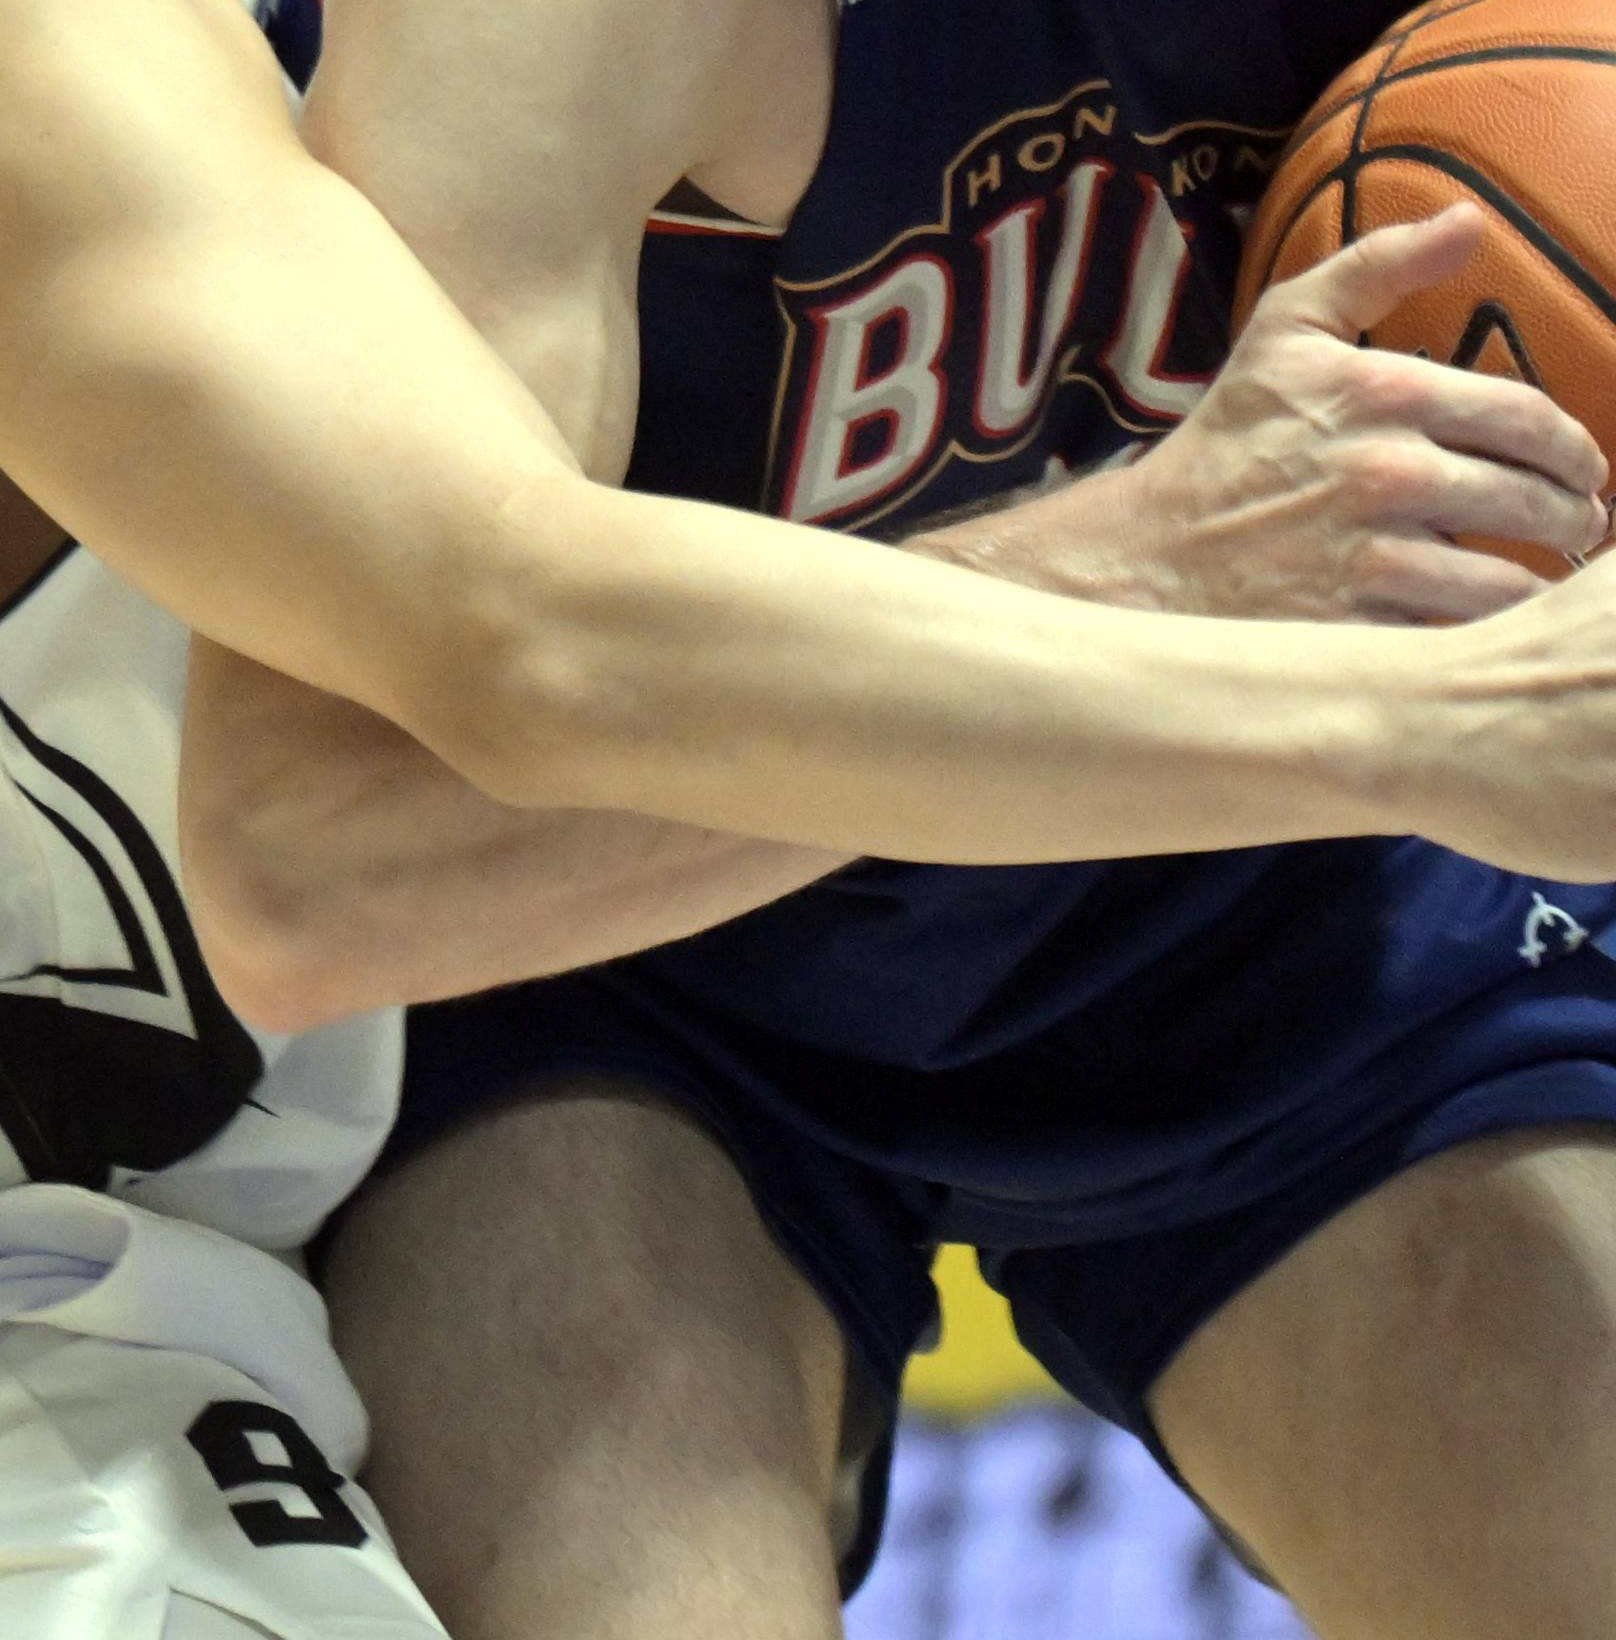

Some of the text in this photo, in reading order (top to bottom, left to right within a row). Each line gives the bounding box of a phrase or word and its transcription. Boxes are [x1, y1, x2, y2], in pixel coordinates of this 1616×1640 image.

[967, 104, 1118, 207] HON
[786, 157, 1244, 524] BUL
[186, 1400, 369, 1548] 9
